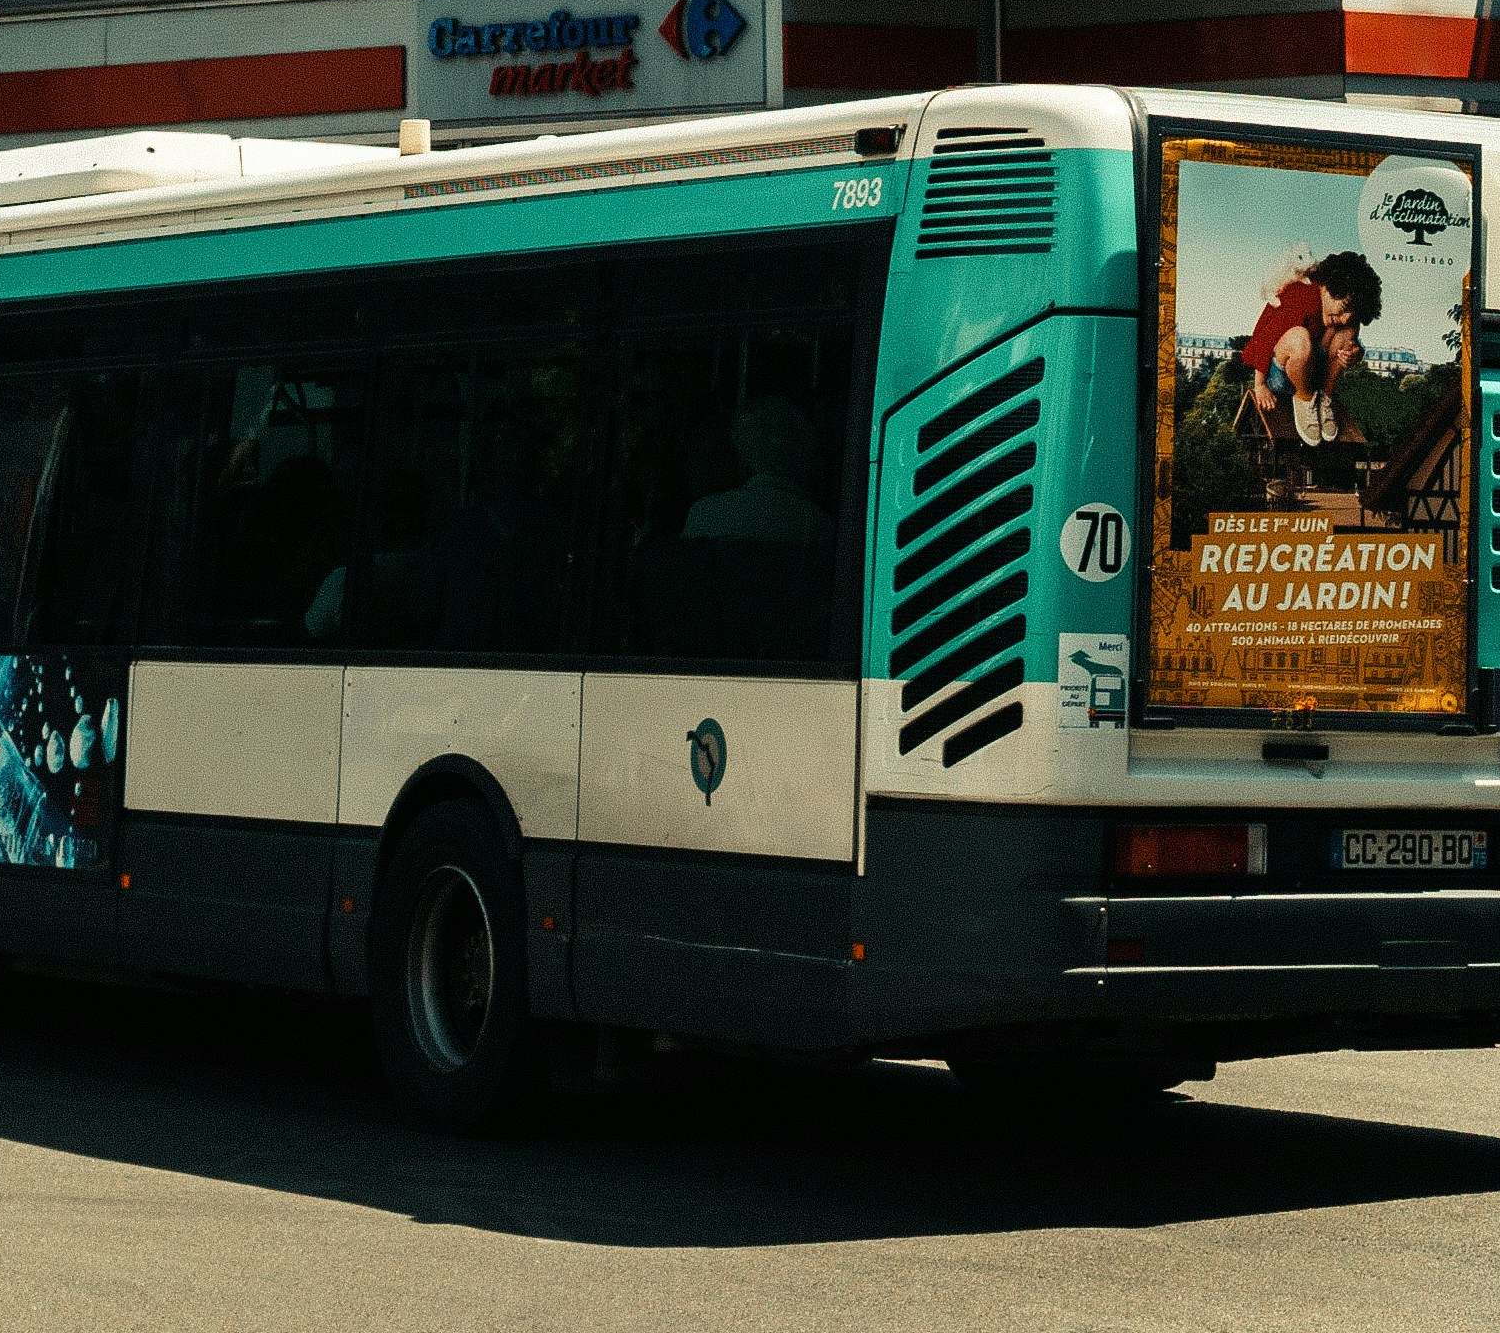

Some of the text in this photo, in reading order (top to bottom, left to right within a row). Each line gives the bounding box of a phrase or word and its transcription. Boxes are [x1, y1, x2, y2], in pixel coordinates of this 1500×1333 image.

[427, 9, 640, 57] Carrefour
[488, 49, 639, 97] market
[832, 177, 883, 210] 7893
[1397, 194, 1442, 212] Jardin
[1369, 204, 1471, 229] d'Acclimatation
[1385, 253, 1415, 263] PARIS
[1424, 256, 1454, 266] 1860
[1214, 514, 1245, 533] DÈS
[1249, 518, 1269, 533] LE
[1290, 517, 1329, 533] JUIN
[1075, 511, 1123, 574] 70
[1199, 535, 1436, 574] R(E)CRÉATION
[1221, 583, 1270, 612] AU
[1185, 622, 1201, 633] 40
[1204, 621, 1278, 633] ATTRACTIONS
[1300, 620, 1353, 632] HECTARES
[1355, 619, 1369, 631] DE
[1371, 619, 1443, 632] PROMENADES
[1099, 642, 1122, 651] Merci
[1231, 635, 1253, 646] 500
[1256, 635, 1305, 646] ANIMAUX
[1318, 633, 1400, 646] R(E)DÉCOUVRIR
